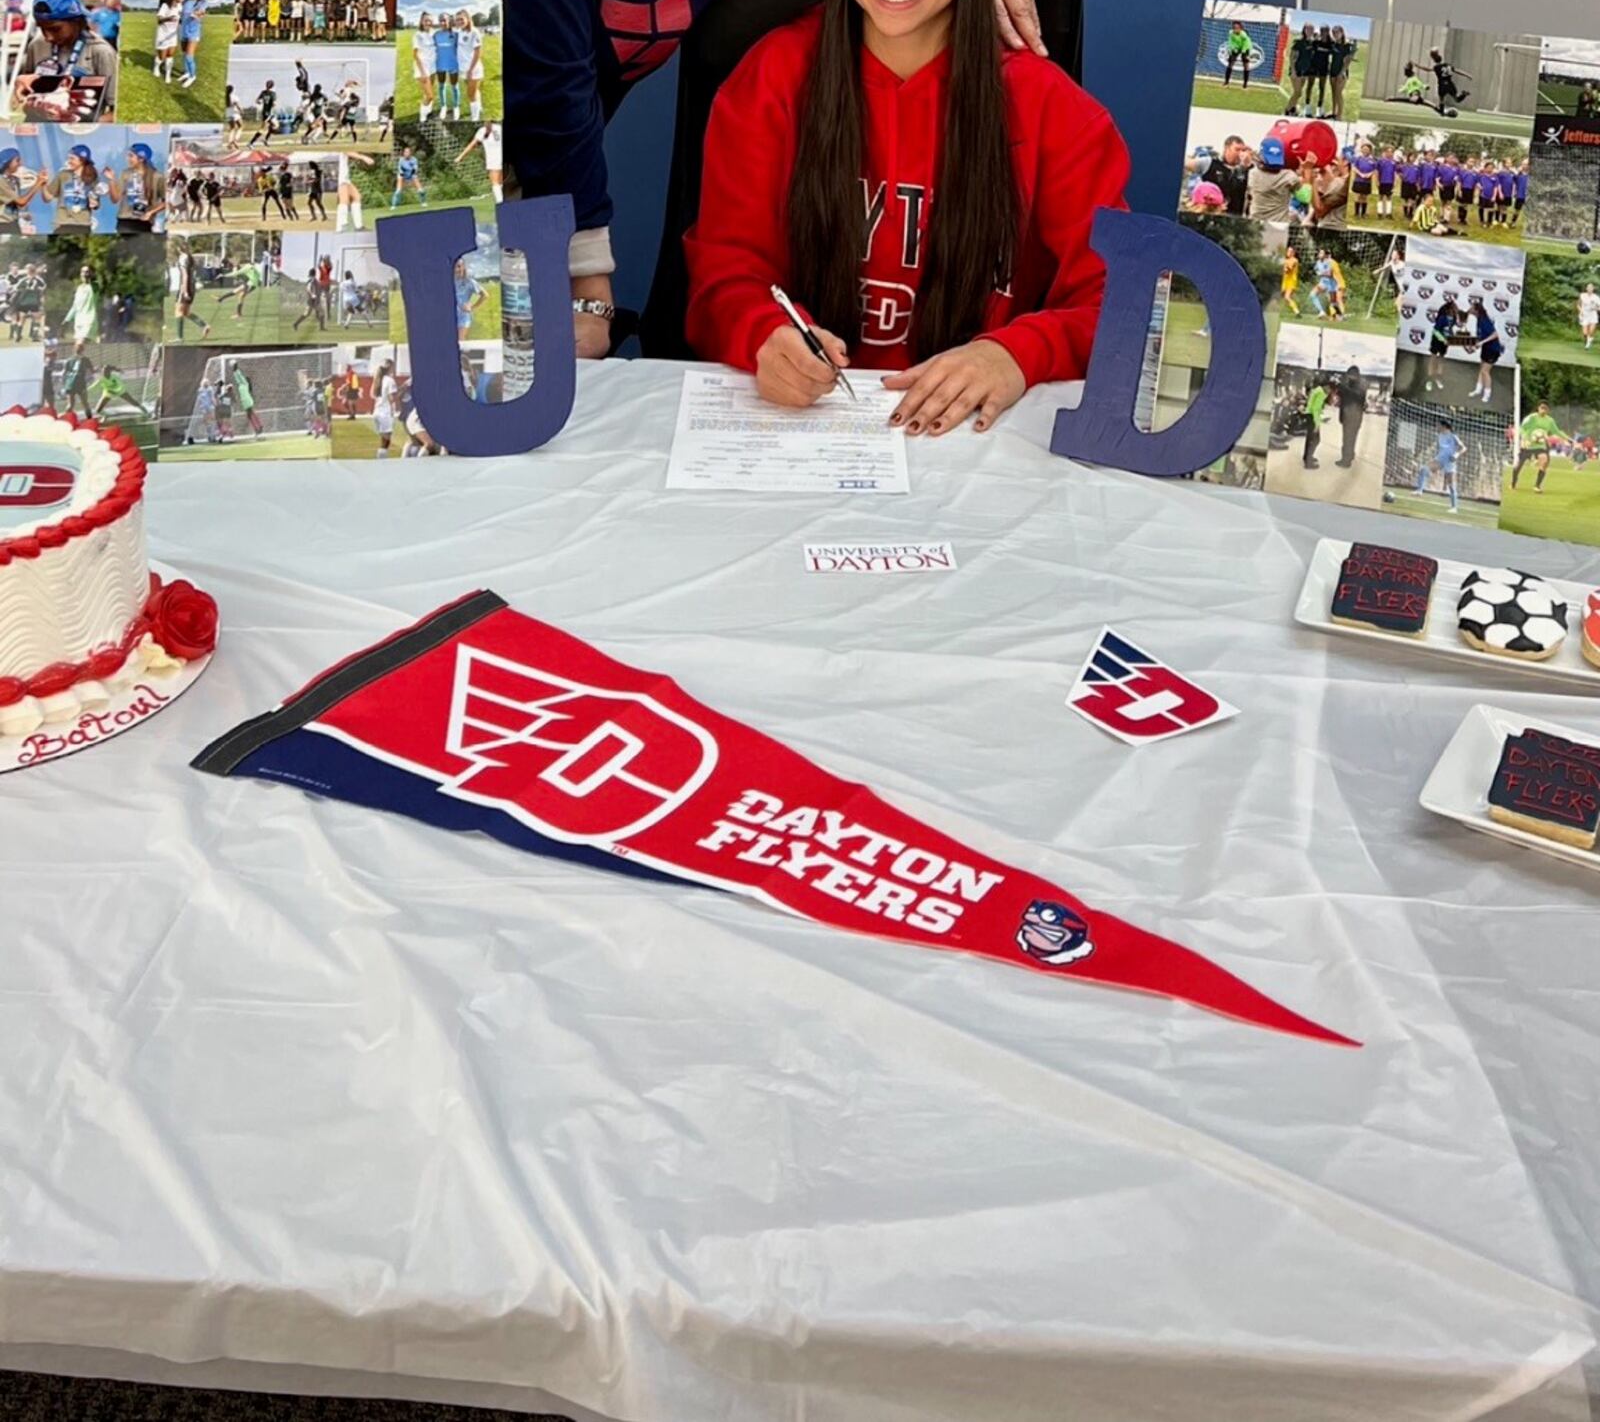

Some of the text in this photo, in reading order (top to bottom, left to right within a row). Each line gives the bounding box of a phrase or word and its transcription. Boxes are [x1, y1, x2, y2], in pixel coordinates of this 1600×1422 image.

[375, 194, 577, 457] U
[1049, 206, 1268, 477] D
[807, 545, 945, 556] UNIVERSITY of
[811, 553, 950, 571] DAYTON
[1345, 558, 1429, 588] DAYTON
[1338, 582, 1428, 614] FLYERS
[17, 684, 170, 764] Batoul
[1502, 770, 1597, 812] FLYERS
[725, 789, 1004, 903] DAYTON
[696, 820, 964, 935] FLYERS
